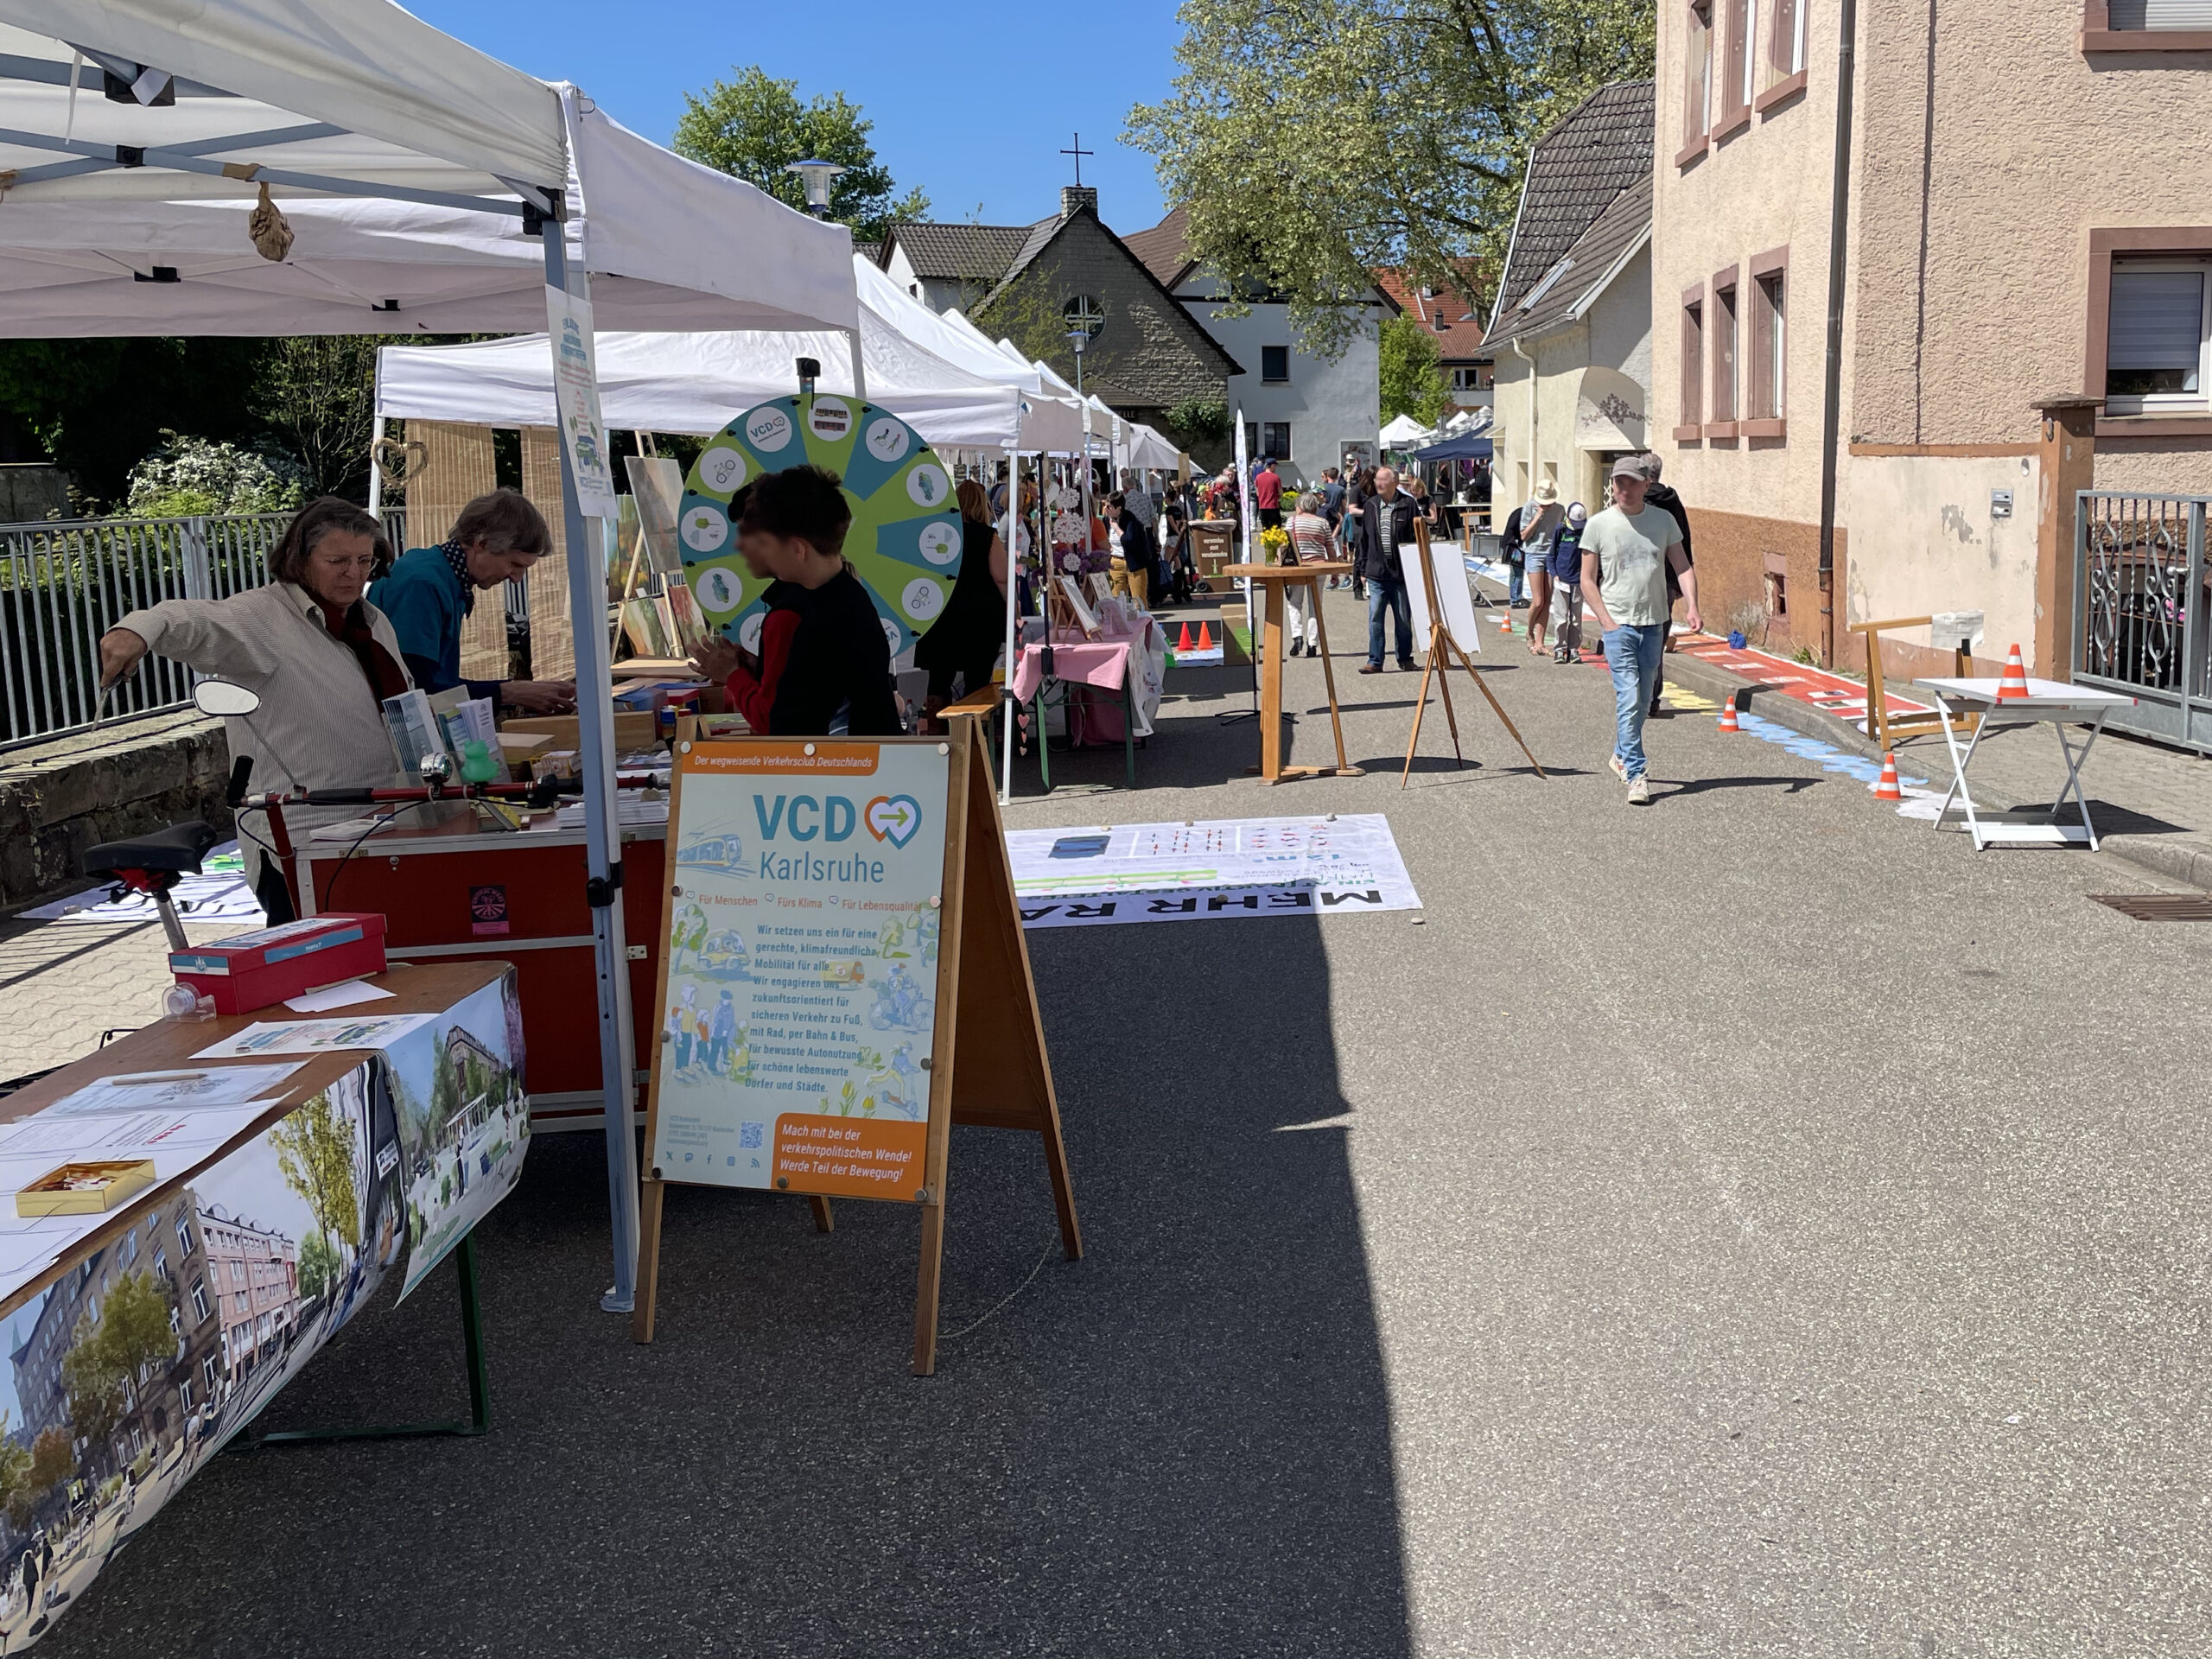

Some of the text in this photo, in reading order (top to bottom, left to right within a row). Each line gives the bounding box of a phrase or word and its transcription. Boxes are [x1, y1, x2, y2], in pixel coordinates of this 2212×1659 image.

[750, 422, 773, 437] VCD
[695, 755, 873, 768] Der wegweisende Verkehrsclub Deutschlands
[753, 794, 856, 842] VCD
[760, 851, 885, 883] Karlsruhe
[699, 894, 922, 913] Für Menschen Fürs Klima Für Lebensqualität
[1020, 890, 1382, 921] MEHR RA
[758, 925, 877, 938] Wir setzen uns ein für eine
[756, 943, 797, 954] gerechte,
[755, 958, 794, 969] Mobilität
[798, 960, 810, 970] für
[753, 976, 839, 989] Wir engagieren uns
[753, 994, 849, 1007] zukunftsorientiert für
[751, 1010, 789, 1021] sicheren
[792, 1012, 827, 1023] Verkehr
[844, 1014, 862, 1027] Fuß,
[750, 1027, 858, 1044] mit Rad, per Bahn & Bus,
[749, 1044, 761, 1052] für
[764, 1045, 804, 1056] bewusste
[747, 1060, 849, 1077] für schöne lebenswerte
[745, 1077, 774, 1089] Dörfer
[777, 1079, 792, 1090] und
[782, 1124, 861, 1141] Mach mit bei der
[781, 1142, 912, 1162] verkehrspolitischen Wende!
[780, 1159, 903, 1182] Werde Teil der Bewegung!
